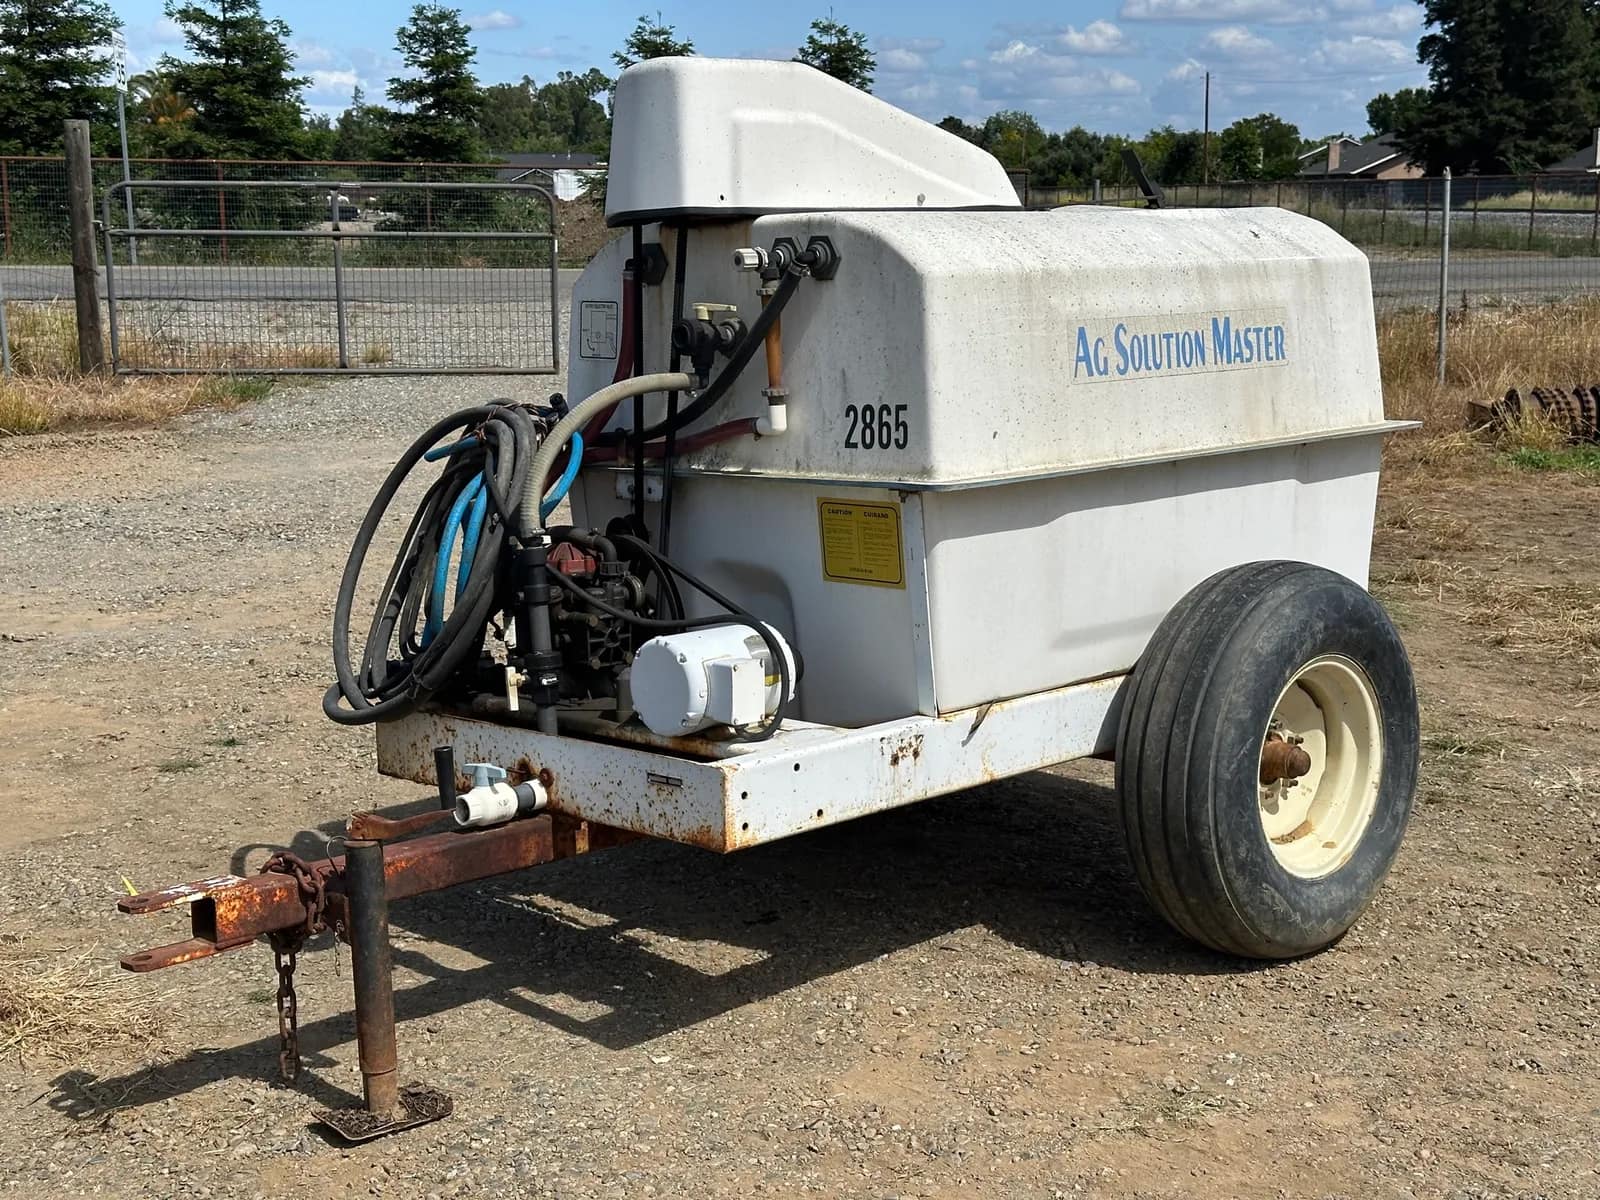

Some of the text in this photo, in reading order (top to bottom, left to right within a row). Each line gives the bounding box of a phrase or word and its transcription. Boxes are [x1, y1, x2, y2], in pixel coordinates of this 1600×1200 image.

[1114, 322, 1206, 376] SOLUTION
[1211, 316, 1287, 366] MASTER
[844, 403, 909, 450] 2865
